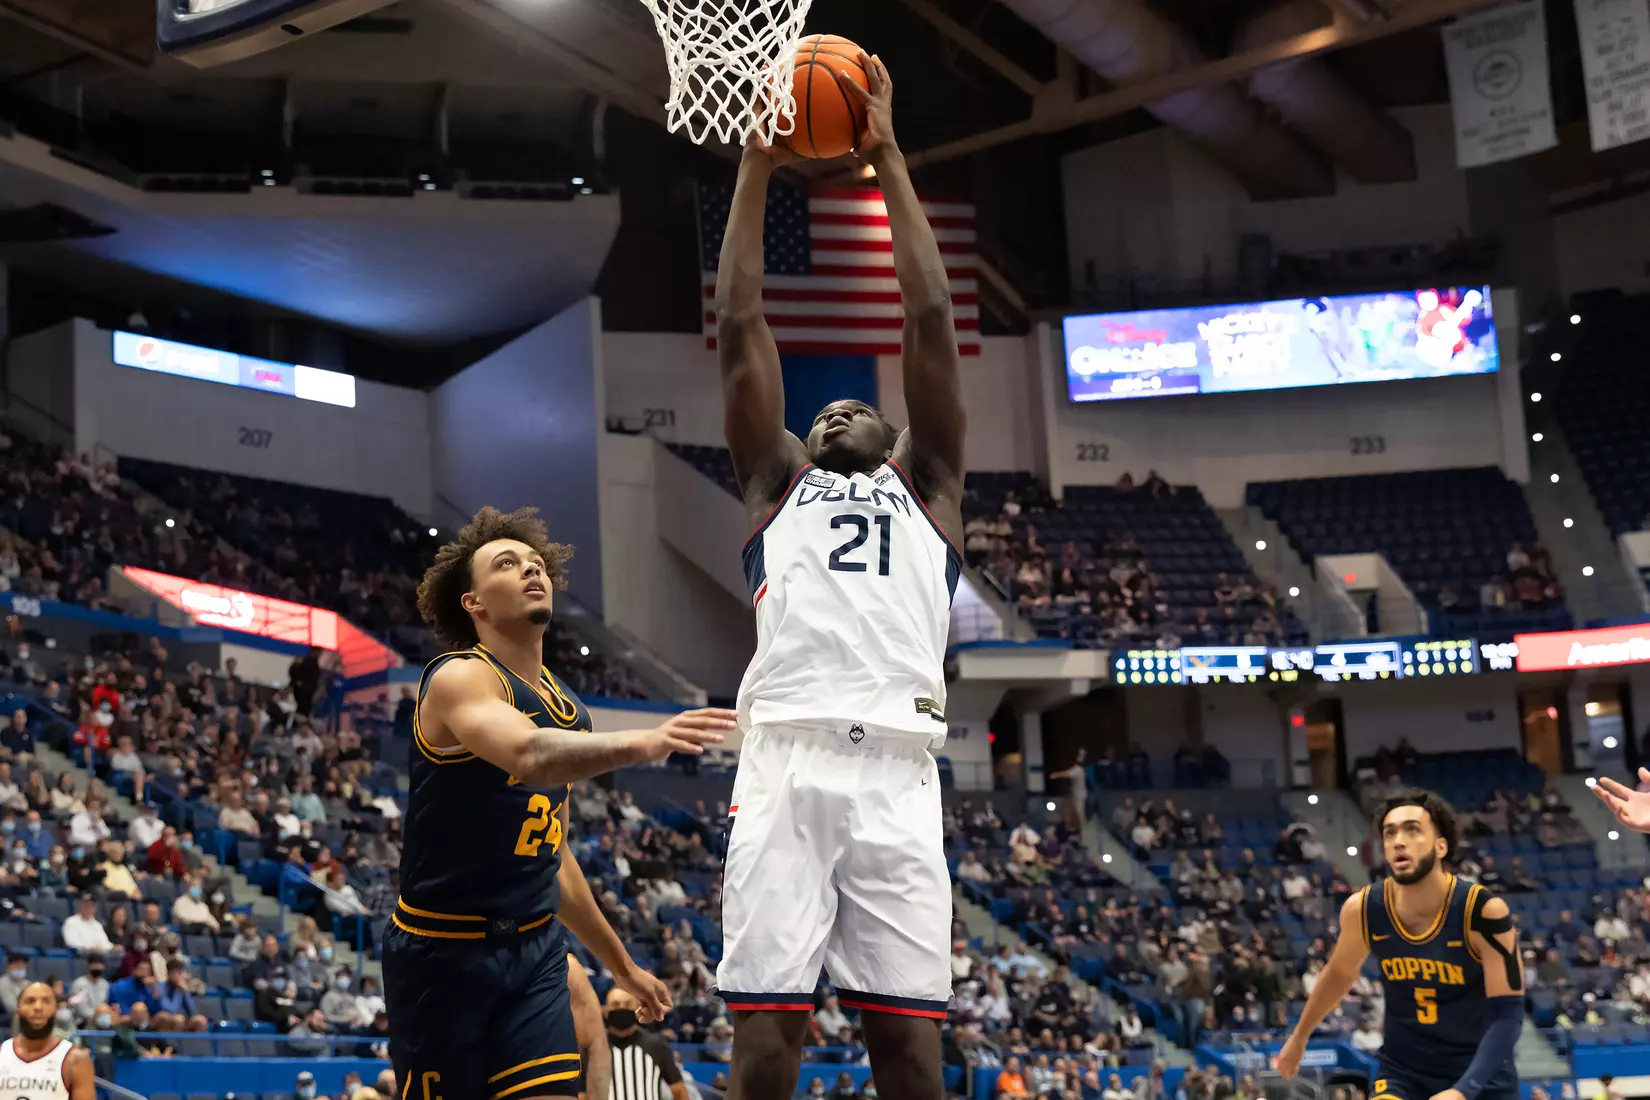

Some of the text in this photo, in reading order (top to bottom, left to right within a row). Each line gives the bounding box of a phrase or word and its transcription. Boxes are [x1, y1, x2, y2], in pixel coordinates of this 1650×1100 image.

[644, 408, 675, 427] 231
[238, 427, 273, 449] 207
[1350, 436, 1386, 455] 233
[1076, 443, 1110, 462] 232
[828, 514, 891, 576] 21
[514, 793, 562, 857] 24
[1381, 957, 1465, 985] COPPIN
[1413, 988, 1439, 1025] 5
